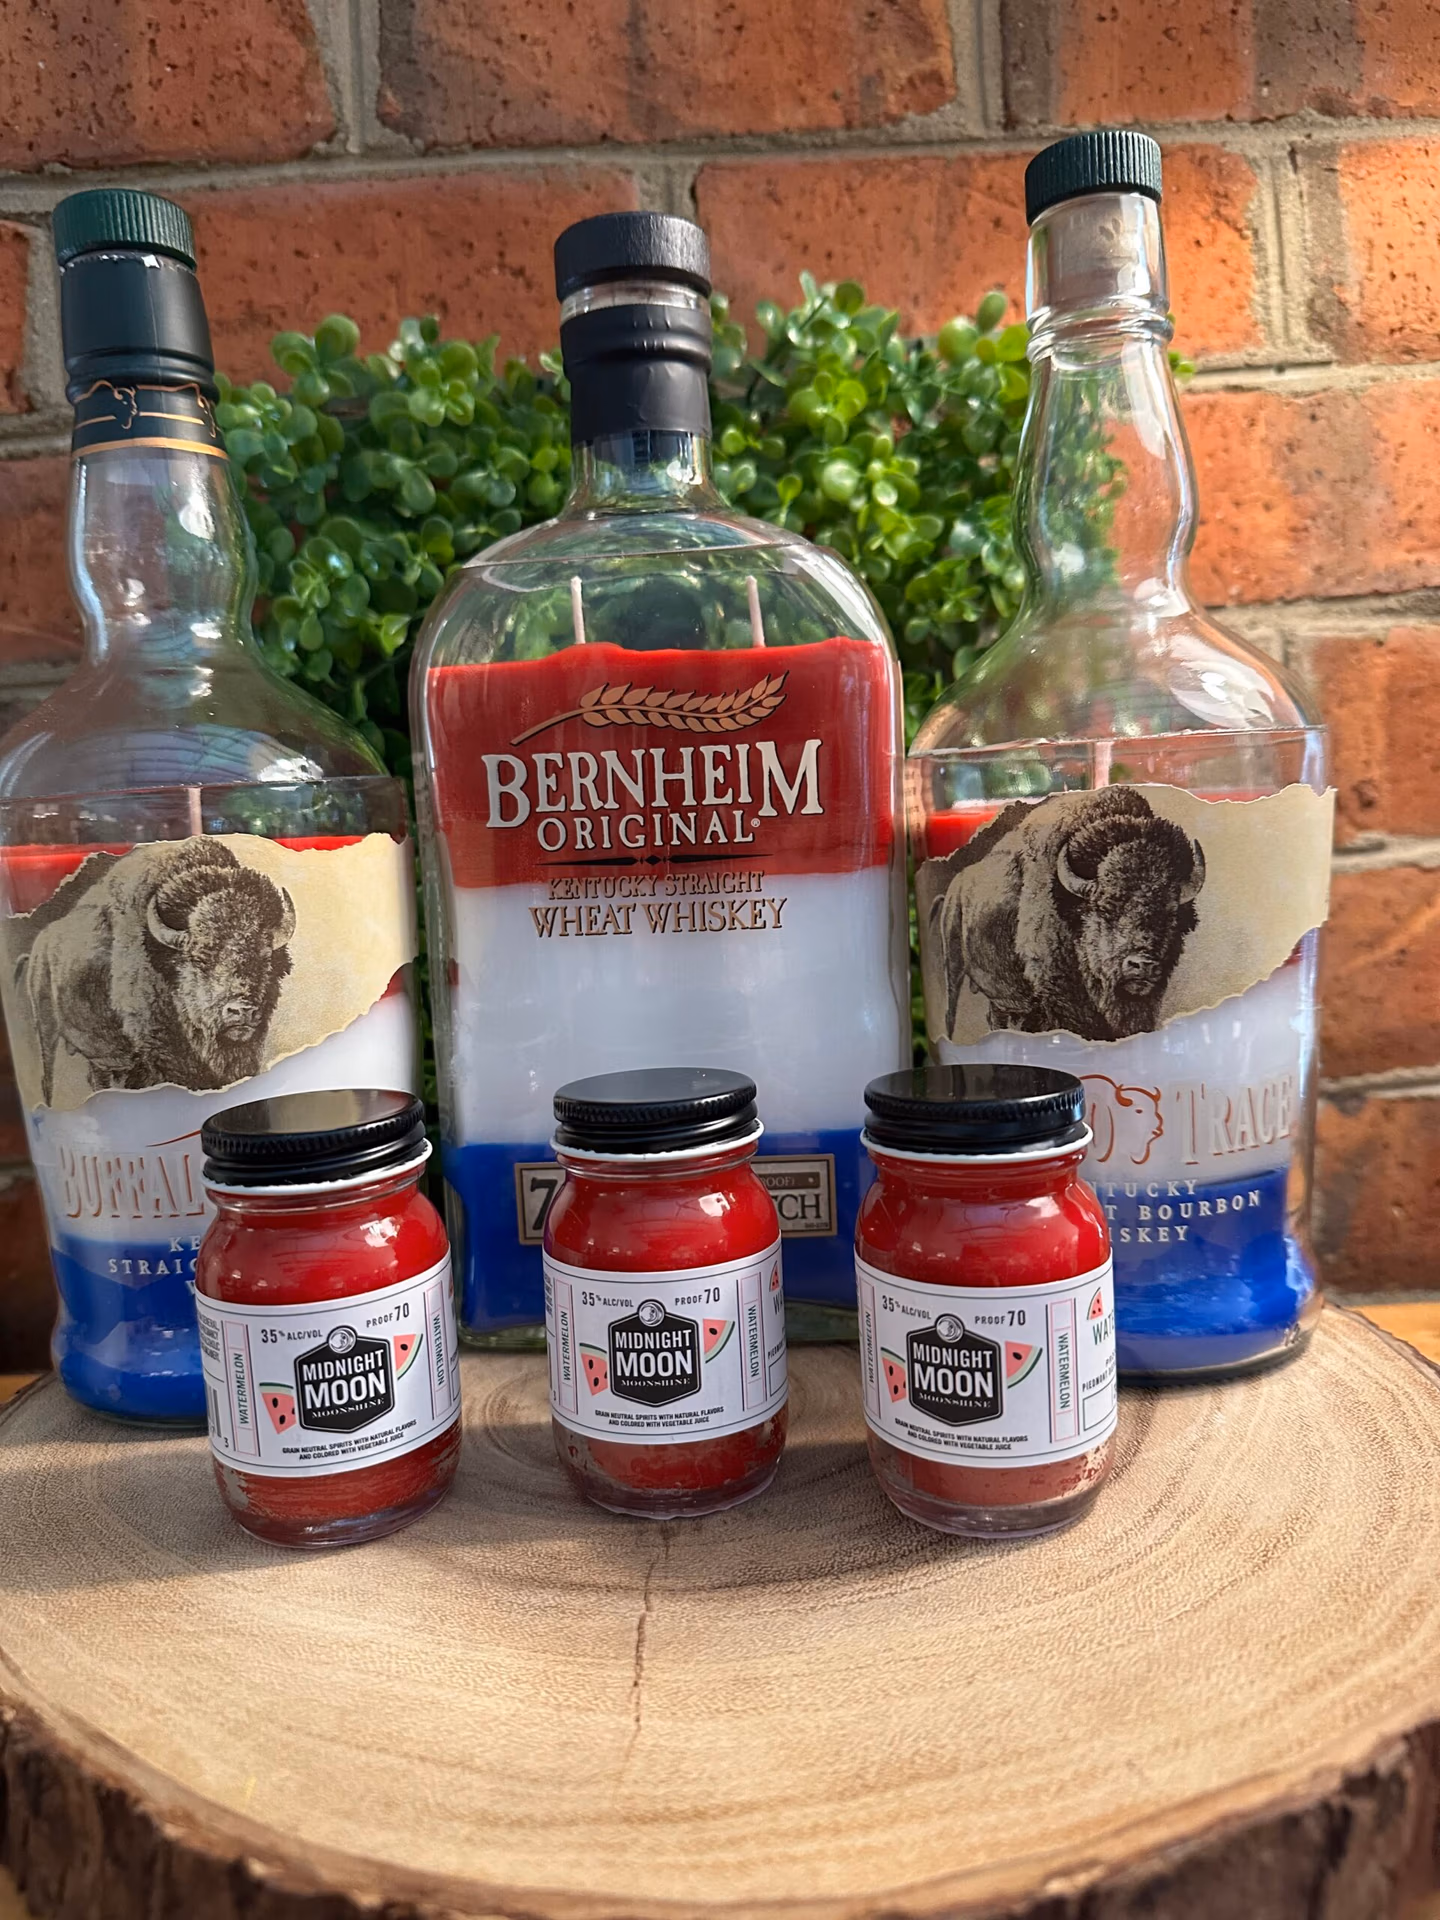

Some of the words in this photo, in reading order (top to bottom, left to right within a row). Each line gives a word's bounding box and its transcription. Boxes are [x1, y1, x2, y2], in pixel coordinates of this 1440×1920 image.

[481, 739, 825, 828] BERNHEIM
[548, 873, 658, 901] KENTUCKY
[664, 871, 765, 897] STRAIGHT
[528, 903, 637, 938] WHEAT
[641, 898, 787, 934] WHISKEY
[1172, 1075, 1294, 1166] TRACE
[1138, 1190, 1261, 1221] BOURBON
[602, 1299, 634, 1308] ALC/VOL
[675, 1295, 703, 1306] PROOF
[703, 1287, 721, 1304] 70
[366, 1313, 394, 1328] PROOF
[394, 1302, 410, 1321] 70
[901, 1305, 932, 1320] ALC/VOL
[974, 1315, 1006, 1325] PROOF
[1007, 1309, 1027, 1326] 70
[287, 1329, 323, 1341] ALC/VOL
[561, 1311, 571, 1381] WATERMELON
[615, 1329, 693, 1350] MIDNIGHT
[748, 1304, 760, 1378] WATERMELON
[865, 1311, 875, 1383] WATERMELON
[433, 1314, 445, 1386] WATERMELON
[616, 1349, 693, 1378] MOON
[912, 1341, 993, 1368] MIDNIGHT
[302, 1349, 385, 1382] MIDNIGHT
[914, 1362, 994, 1398] MOON
[1058, 1332, 1071, 1409] WATERMELON
[233, 1353, 249, 1424] WATERMELON
[304, 1369, 387, 1410] MOON
[621, 1377, 691, 1387] MOONSHINE
[311, 1397, 385, 1418] MOONSHINE
[594, 1409, 610, 1418] GRAIN
[611, 1412, 633, 1420] NEUTRAL
[675, 1411, 700, 1419] NATURAL
[700, 1406, 725, 1416] FLAVORS
[919, 1392, 991, 1408] MOONSHINE
[282, 1446, 300, 1454] GRAIN
[301, 1445, 327, 1454] NEUTRAL
[329, 1440, 353, 1450] SPIRITS
[354, 1436, 369, 1445] WITH
[370, 1428, 394, 1441] NATURAL
[395, 1419, 417, 1434] FLAVORS
[609, 1418, 620, 1426] AND
[620, 1419, 645, 1428] COLORED
[661, 1418, 693, 1427] VEGETABLE
[694, 1416, 710, 1424] JUICE
[909, 1423, 932, 1436] NEUTRAL
[932, 1430, 956, 1440] SPIRITS
[957, 1434, 972, 1442] WITH
[973, 1435, 1001, 1443] NATURAL
[1002, 1435, 1028, 1443] FLAVORS
[299, 1452, 312, 1461] AND
[313, 1448, 339, 1459] COLORED
[341, 1447, 357, 1455] WITH
[358, 1438, 388, 1451] VEGETABLE
[389, 1432, 404, 1443] JUICE
[907, 1430, 918, 1439] AND
[918, 1433, 942, 1445] COLORED
[943, 1439, 959, 1447] WITH
[960, 1442, 993, 1450] VEGETABLE
